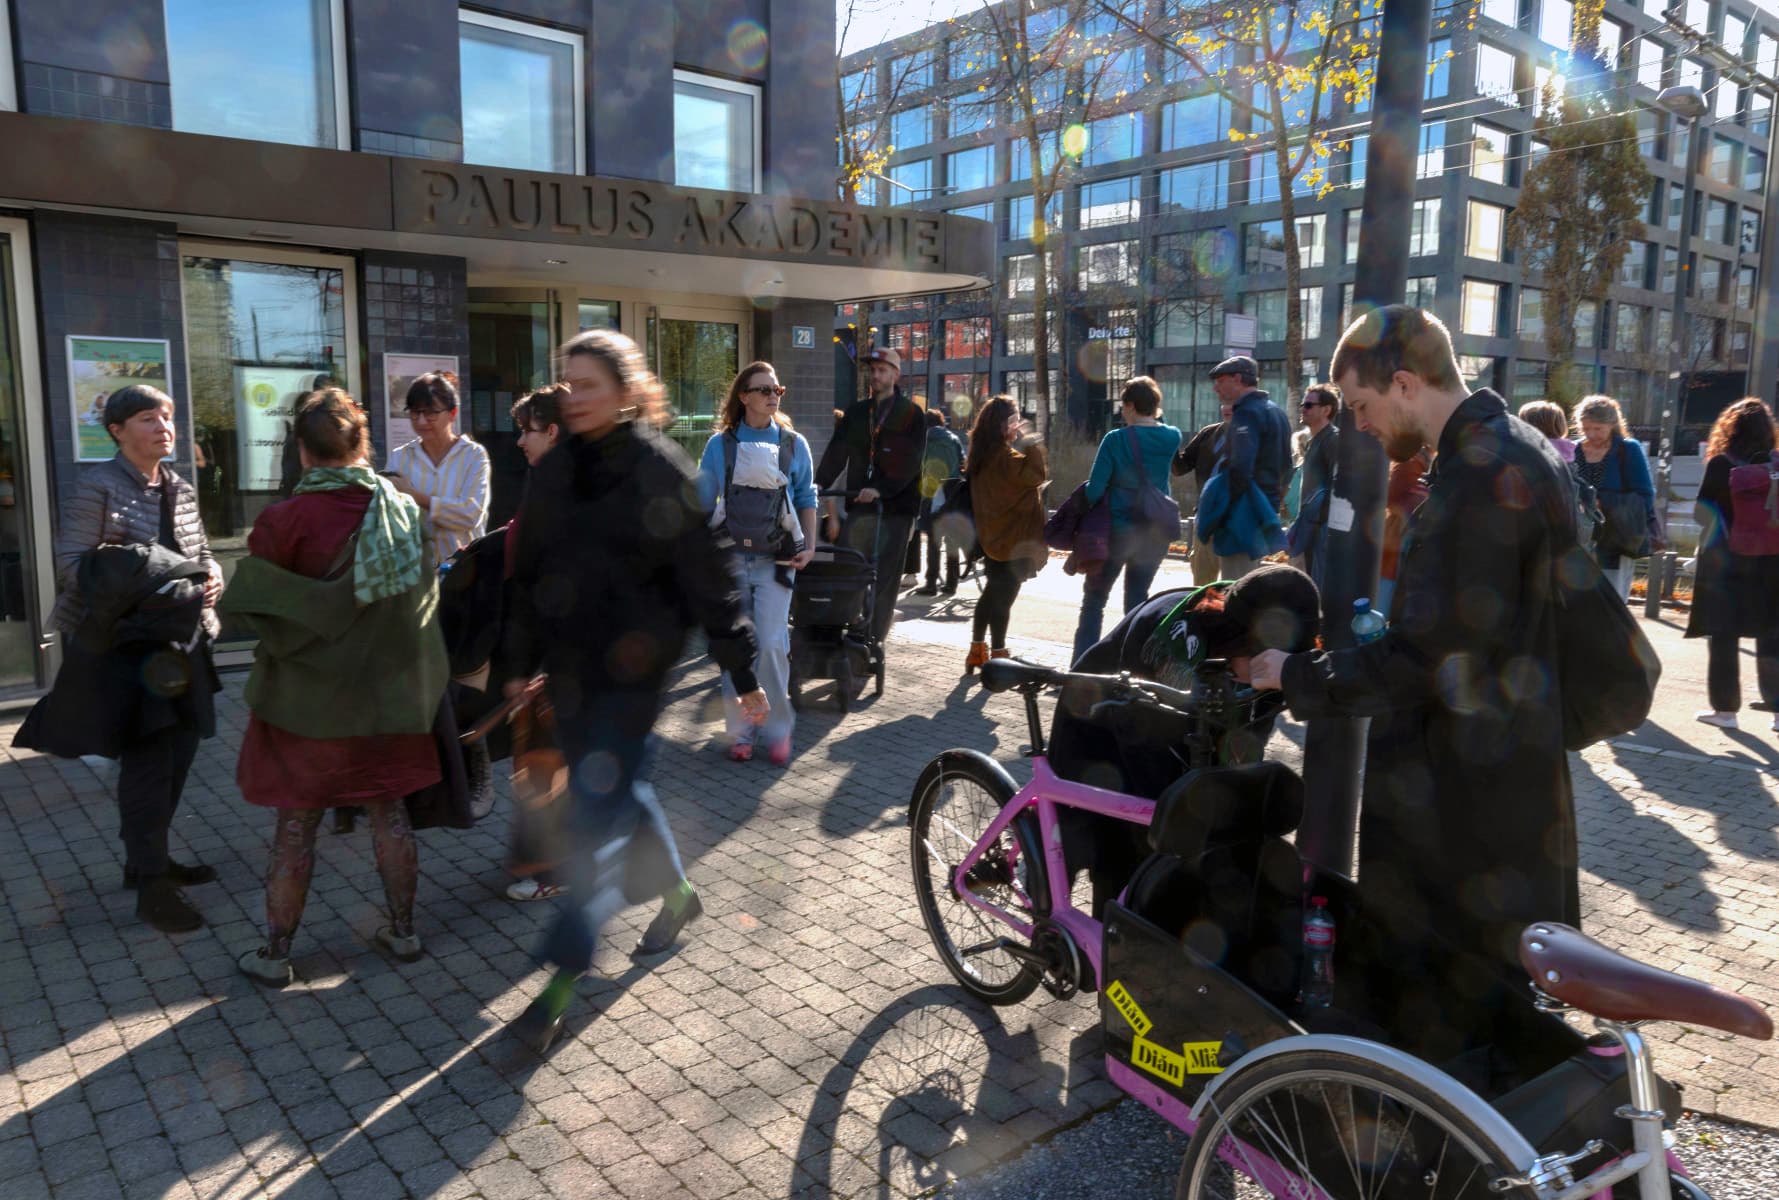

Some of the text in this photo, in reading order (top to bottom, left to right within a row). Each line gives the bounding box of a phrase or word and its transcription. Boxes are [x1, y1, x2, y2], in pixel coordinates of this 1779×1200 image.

[419, 168, 940, 265] PAULUS AKADEMIE
[798, 330, 810, 345] 28
